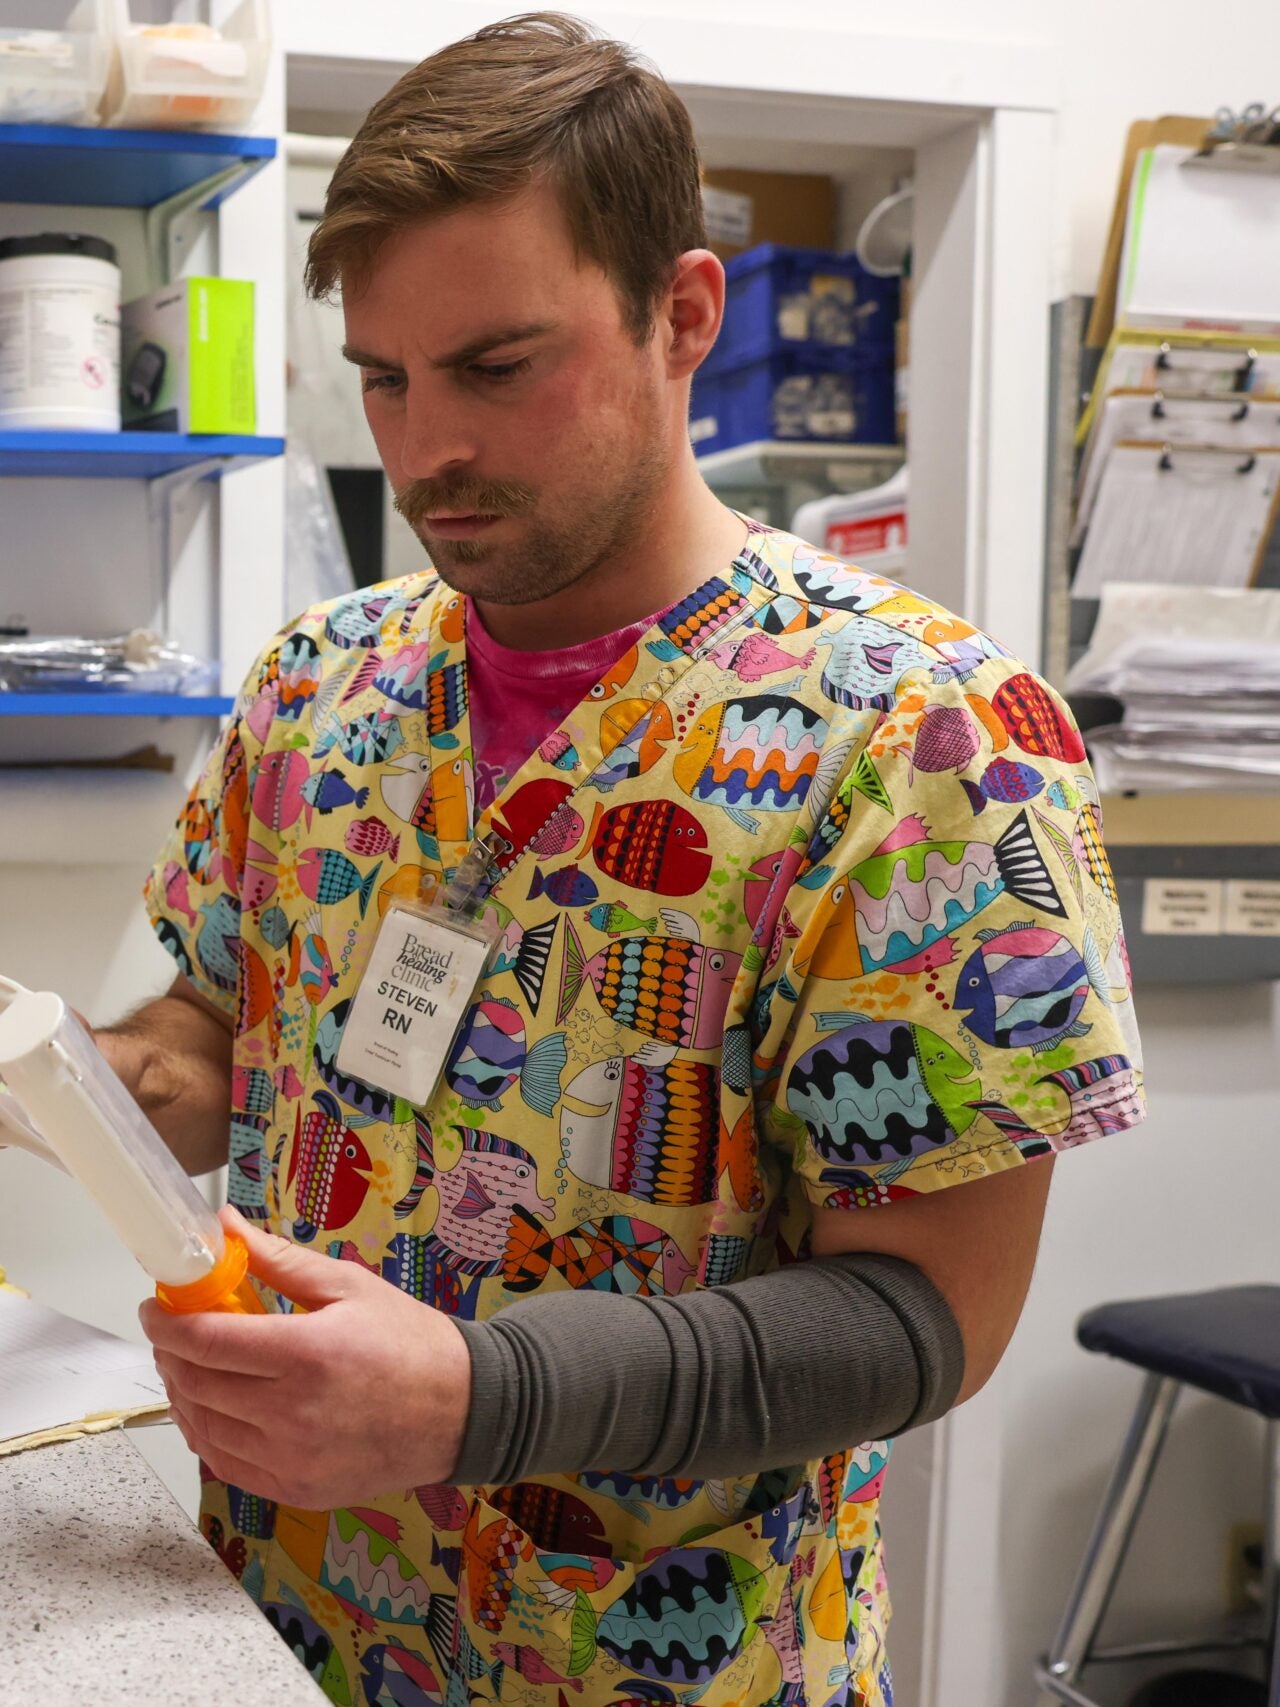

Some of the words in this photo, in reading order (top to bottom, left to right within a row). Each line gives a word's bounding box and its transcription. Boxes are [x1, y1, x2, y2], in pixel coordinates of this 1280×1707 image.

[396, 950, 447, 984] healing
[401, 932, 454, 969] Bread
[391, 963, 436, 992] clinic
[377, 981, 438, 1018] STEVEN
[382, 1007, 413, 1035] RN
